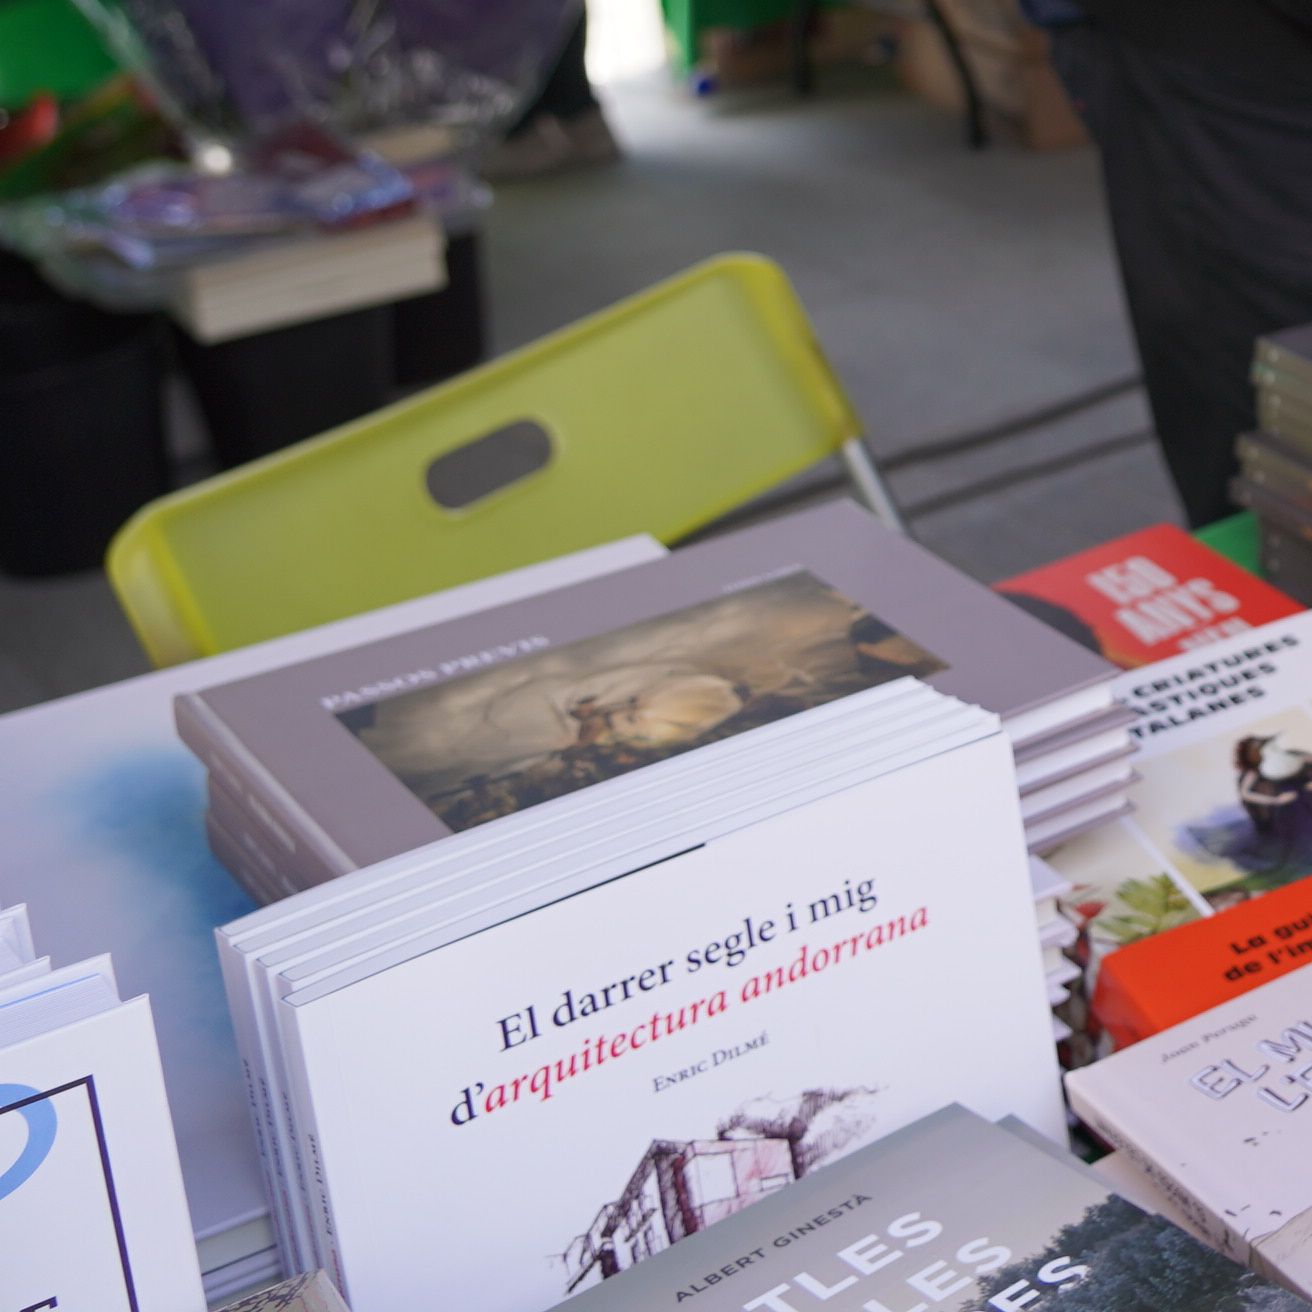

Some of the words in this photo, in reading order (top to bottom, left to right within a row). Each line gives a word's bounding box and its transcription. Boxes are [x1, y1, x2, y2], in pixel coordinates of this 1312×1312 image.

[1132, 636, 1299, 698] CRIATURES
[497, 1005, 540, 1052] El
[551, 959, 674, 1030] darrer
[686, 916, 776, 975] segle
[785, 903, 800, 932] i
[809, 877, 880, 925] mig
[1224, 958, 1263, 983] de
[1231, 934, 1267, 956] La
[450, 990, 728, 1128] d'arquitectura
[741, 904, 930, 1003] andorrana
[652, 1059, 708, 1094] ENRIC
[1189, 1058, 1271, 1102] EL
[675, 1246, 767, 1303] ALBERT
[772, 1193, 872, 1249] GINESTÀ
